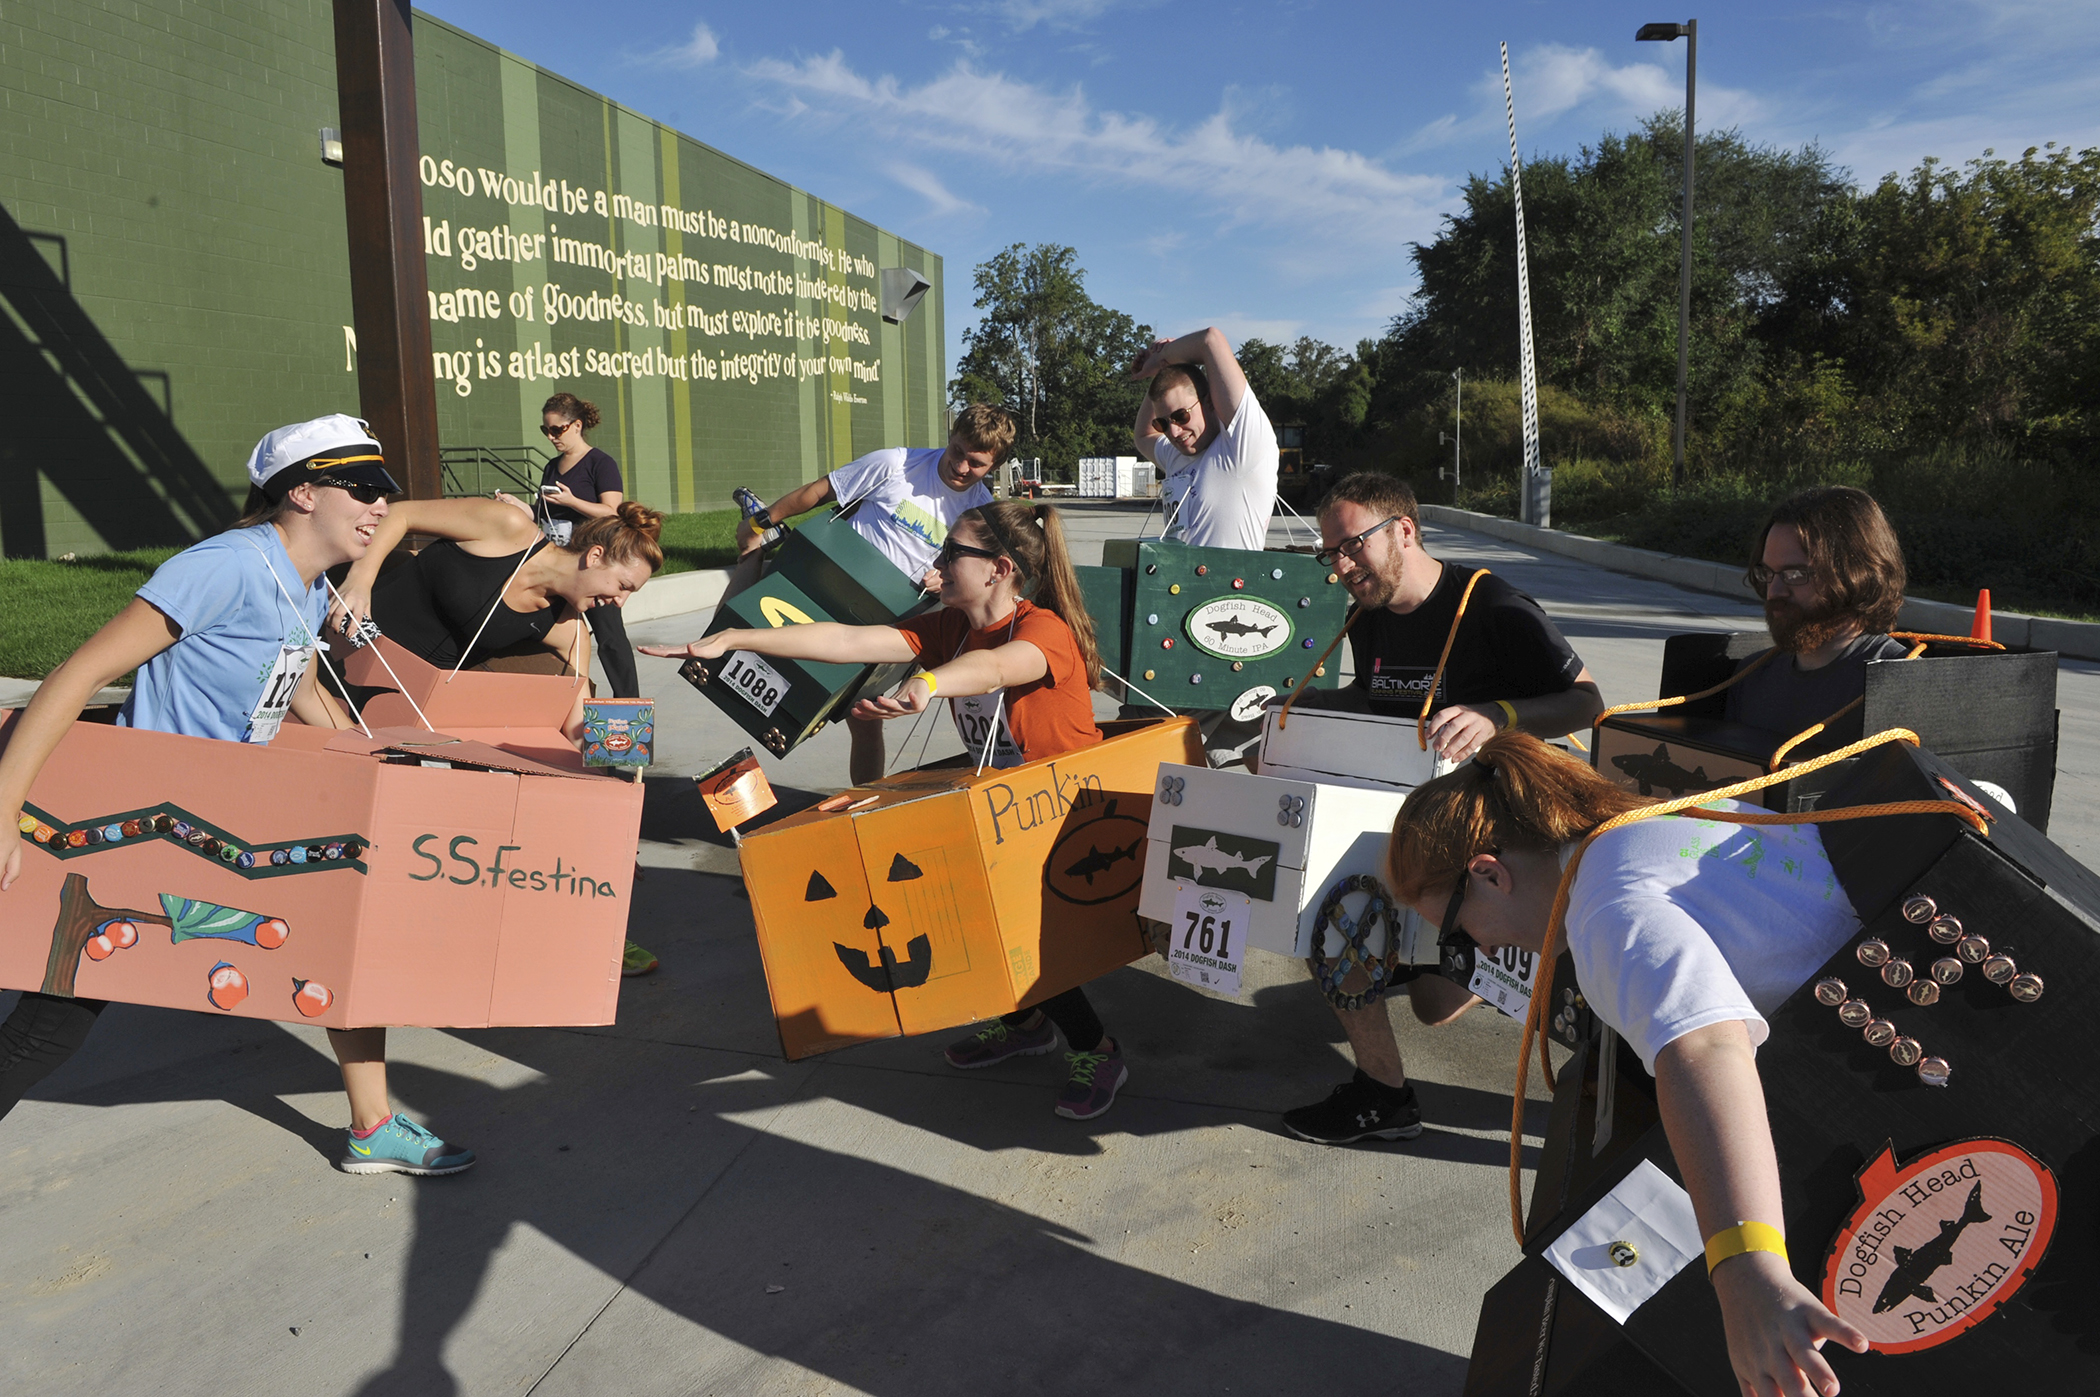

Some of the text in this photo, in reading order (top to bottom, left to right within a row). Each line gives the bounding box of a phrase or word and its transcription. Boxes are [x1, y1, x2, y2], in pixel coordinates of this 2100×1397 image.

[478, 167, 558, 213] would
[561, 179, 589, 216] be
[594, 189, 609, 218] a
[612, 193, 658, 228] man
[660, 202, 707, 238] must
[708, 210, 728, 241] be
[730, 221, 741, 243] a
[838, 247, 853, 275] He
[853, 253, 875, 279] who
[457, 225, 546, 272] gather
[551, 224, 653, 283] immortal
[655, 252, 710, 287] palms
[713, 265, 753, 292] must
[753, 272, 777, 296] not
[778, 273, 794, 296] be
[796, 272, 847, 308] hindered
[847, 289, 859, 314] by
[860, 288, 877, 314] the
[427, 283, 871, 346] name of goodness, but must explore if it be goodness.
[475, 337, 502, 380] is
[585, 346, 653, 380] sacred
[656, 346, 688, 383] but
[690, 348, 718, 381] the
[720, 349, 782, 385] integrity
[783, 352, 797, 379] of
[799, 359, 827, 383] your
[829, 355, 852, 376] own
[1205, 601, 1278, 622] Dogfish Head
[1203, 636, 1269, 654] 60 Minute IPA
[727, 659, 779, 707] 1088
[957, 712, 1012, 748] 1202
[982, 762, 1105, 845] Punkin
[1183, 911, 1232, 959] 761
[1174, 949, 1189, 962] 2014
[1190, 954, 1218, 969] DOGFISH
[1218, 960, 1237, 974] DASH
[1480, 960, 1495, 977] 2014
[1495, 967, 1520, 992] DOGFISH
[1519, 985, 1533, 999] DAS
[1839, 1158, 1981, 1299] Dogfish Head
[1903, 1209, 2035, 1335] Punkin Ale
